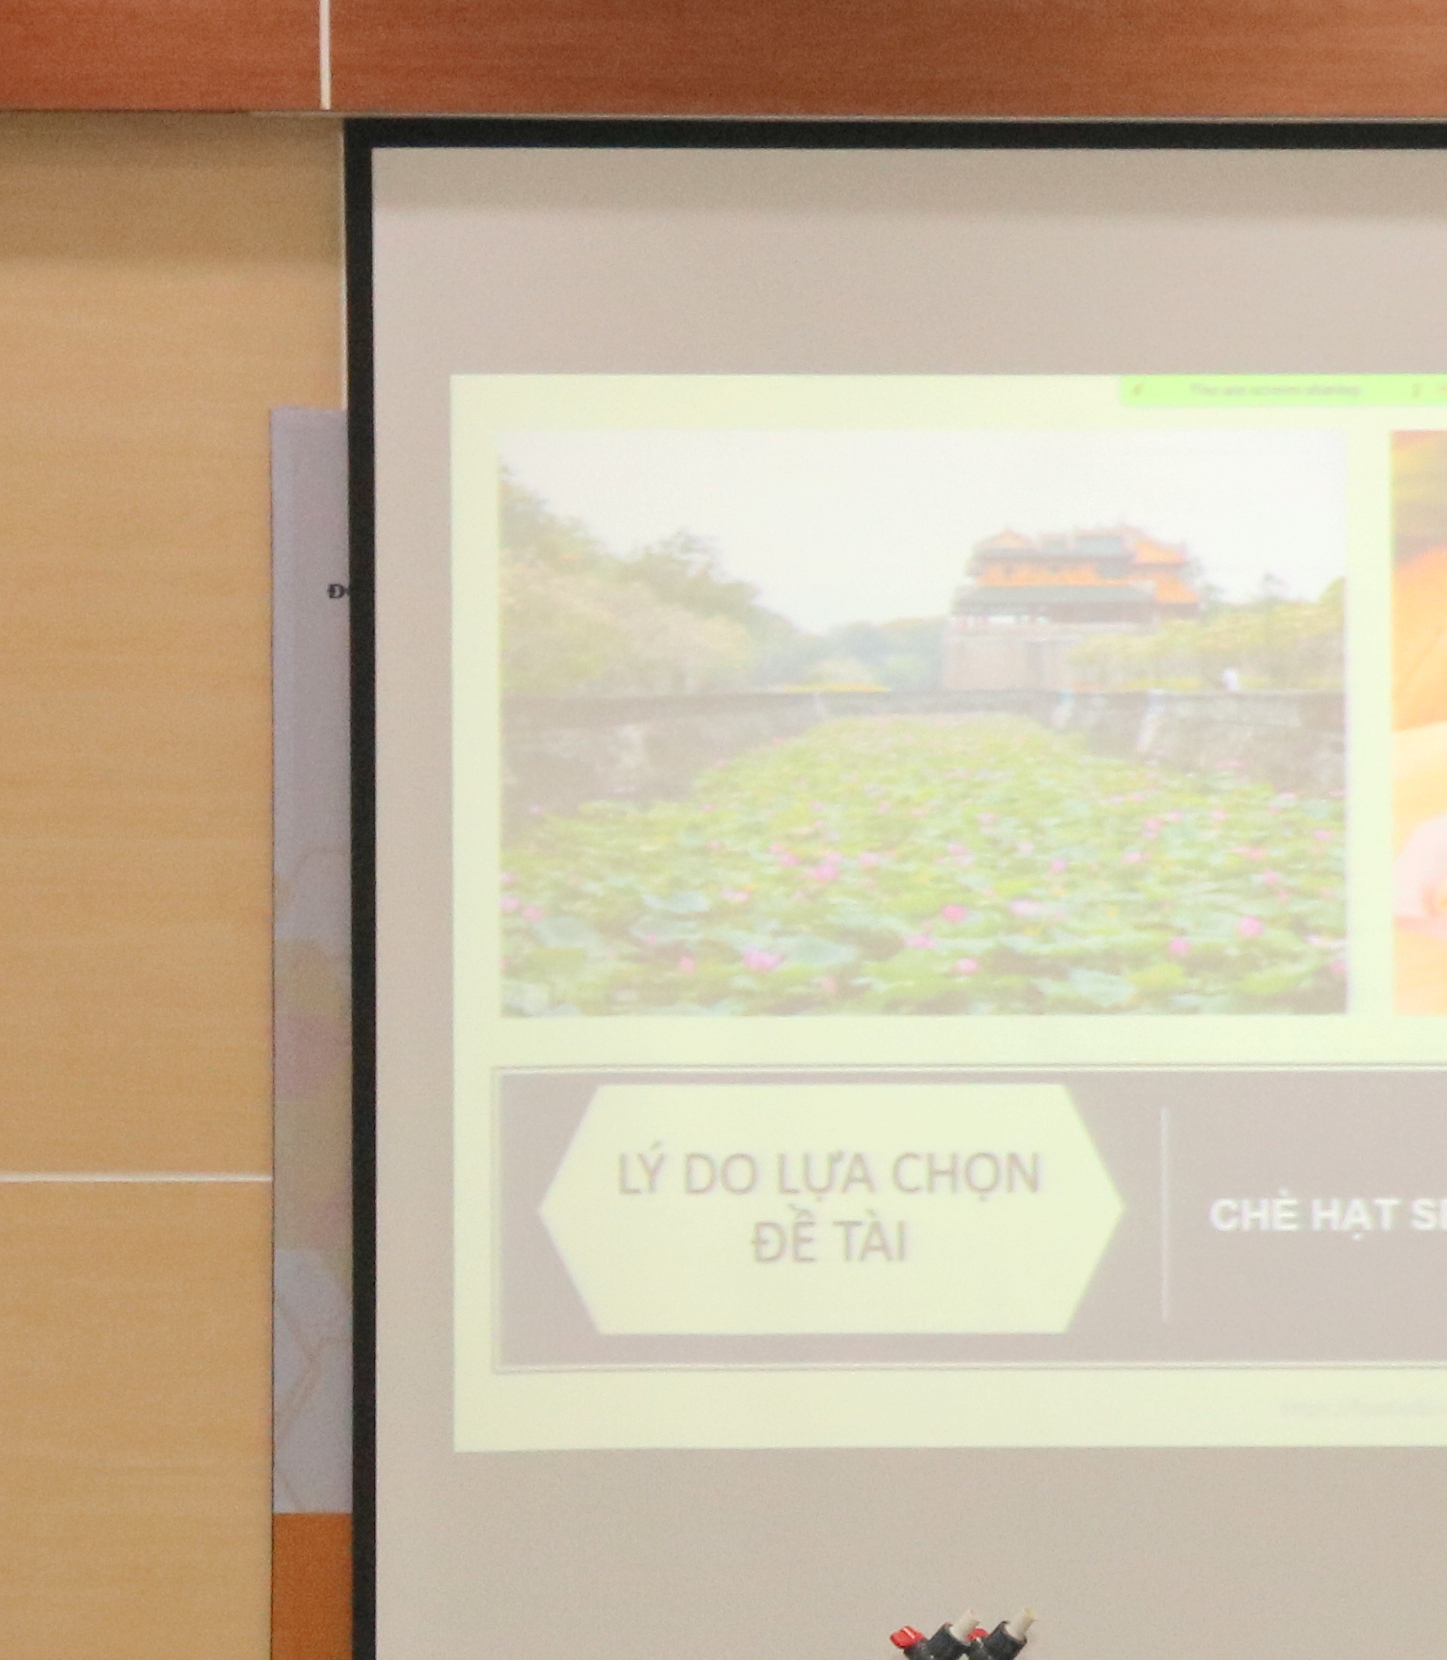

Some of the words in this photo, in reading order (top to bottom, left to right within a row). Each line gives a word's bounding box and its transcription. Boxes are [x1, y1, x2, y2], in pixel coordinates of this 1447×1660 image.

[618, 1140, 668, 1195] LÝ
[683, 1151, 761, 1196] DO
[776, 1147, 878, 1203] LỰA
[892, 1151, 1044, 1203] CHỌN
[749, 1204, 818, 1263] ĐỀ
[833, 1207, 911, 1263] TÀI
[1210, 1188, 1302, 1232] CHÈ
[1311, 1198, 1397, 1241] HẠT
